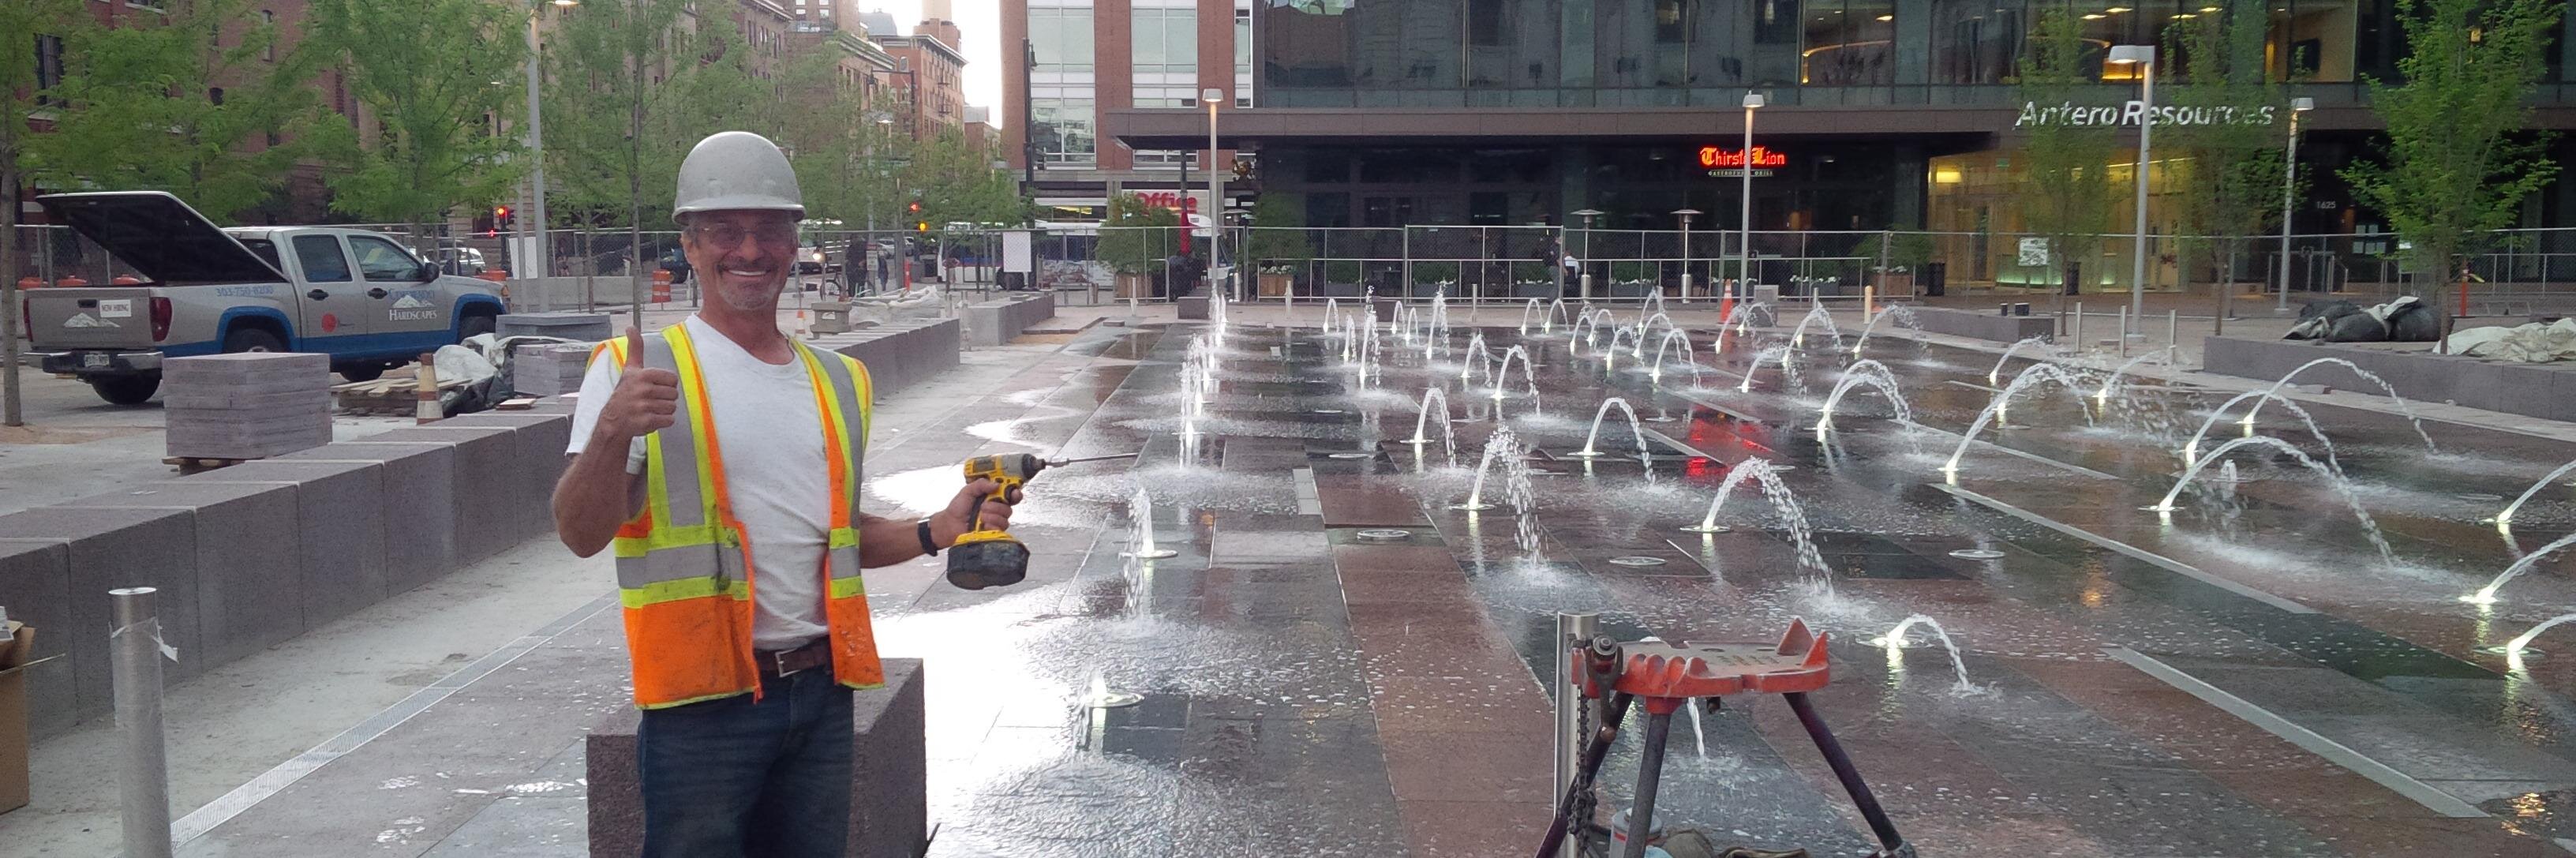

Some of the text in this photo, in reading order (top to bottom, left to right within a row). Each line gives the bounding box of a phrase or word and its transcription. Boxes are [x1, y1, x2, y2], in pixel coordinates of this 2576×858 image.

[2014, 101, 2118, 126] Antero
[1699, 147, 1785, 166] Thirst Lion
[2316, 200, 2336, 209] 1625
[389, 309, 438, 321] HARDSCAPES
